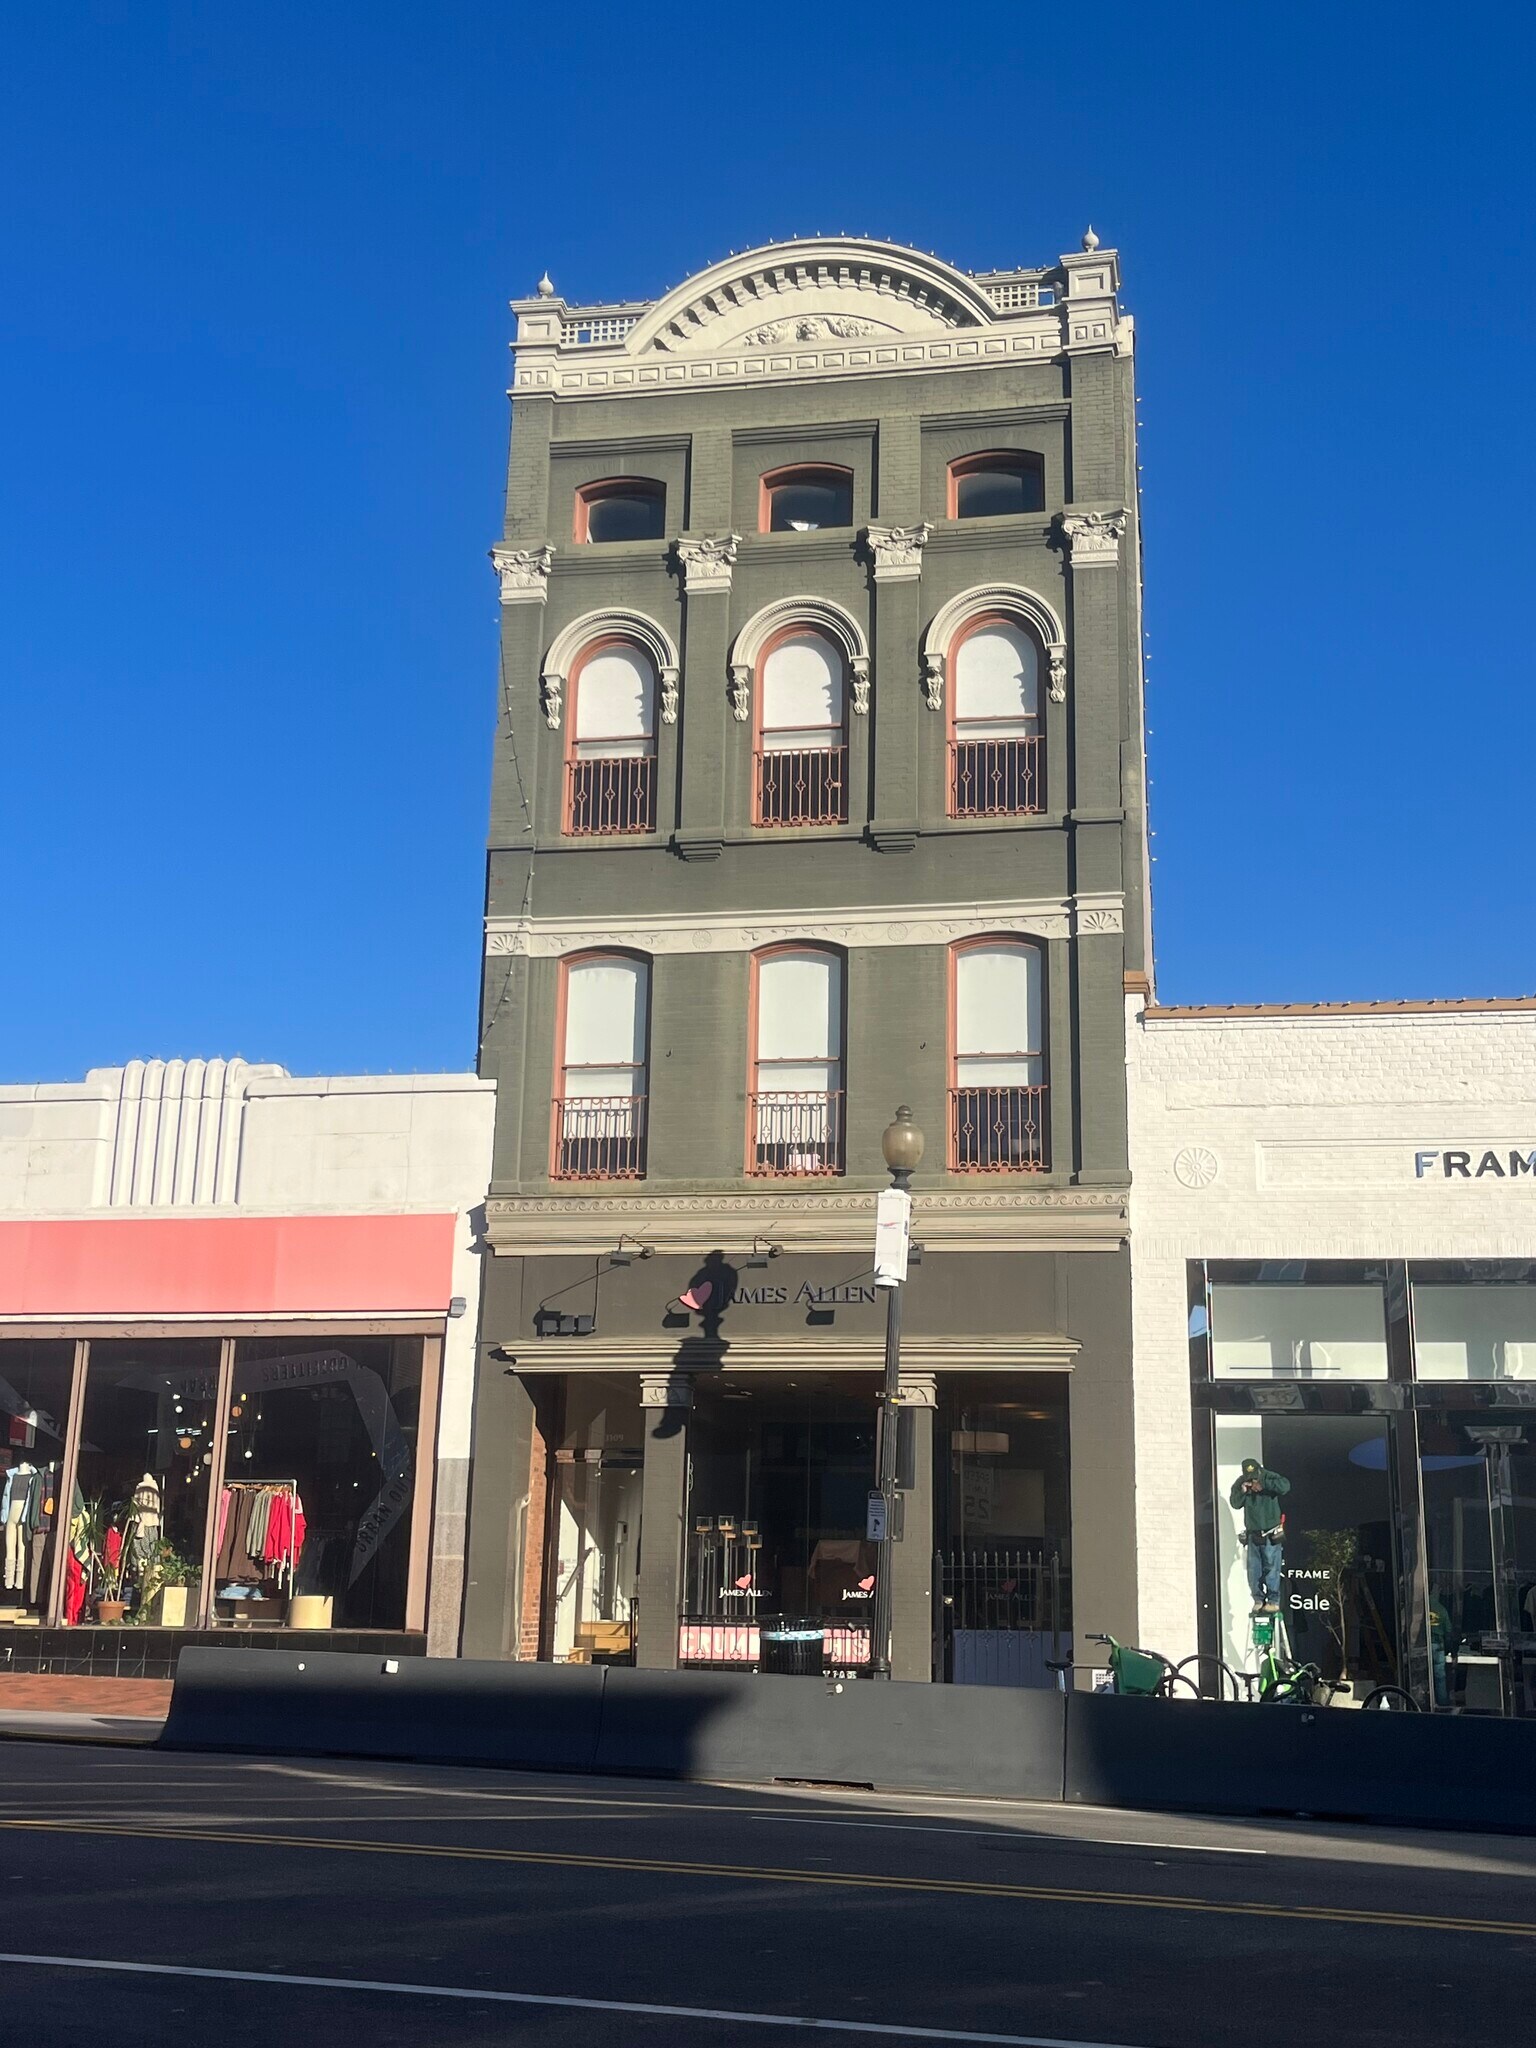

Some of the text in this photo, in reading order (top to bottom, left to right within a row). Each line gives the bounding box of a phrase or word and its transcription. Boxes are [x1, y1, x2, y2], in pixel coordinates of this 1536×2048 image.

[1415, 1151, 1536, 1178] FRAM
[794, 1280, 877, 1304] ALLEN
[1287, 1569, 1330, 1579] FRAME
[719, 1586, 773, 1599] JAMES ALLEN
[842, 1589, 868, 1600] JAMES
[1290, 1594, 1330, 1611] Sale
